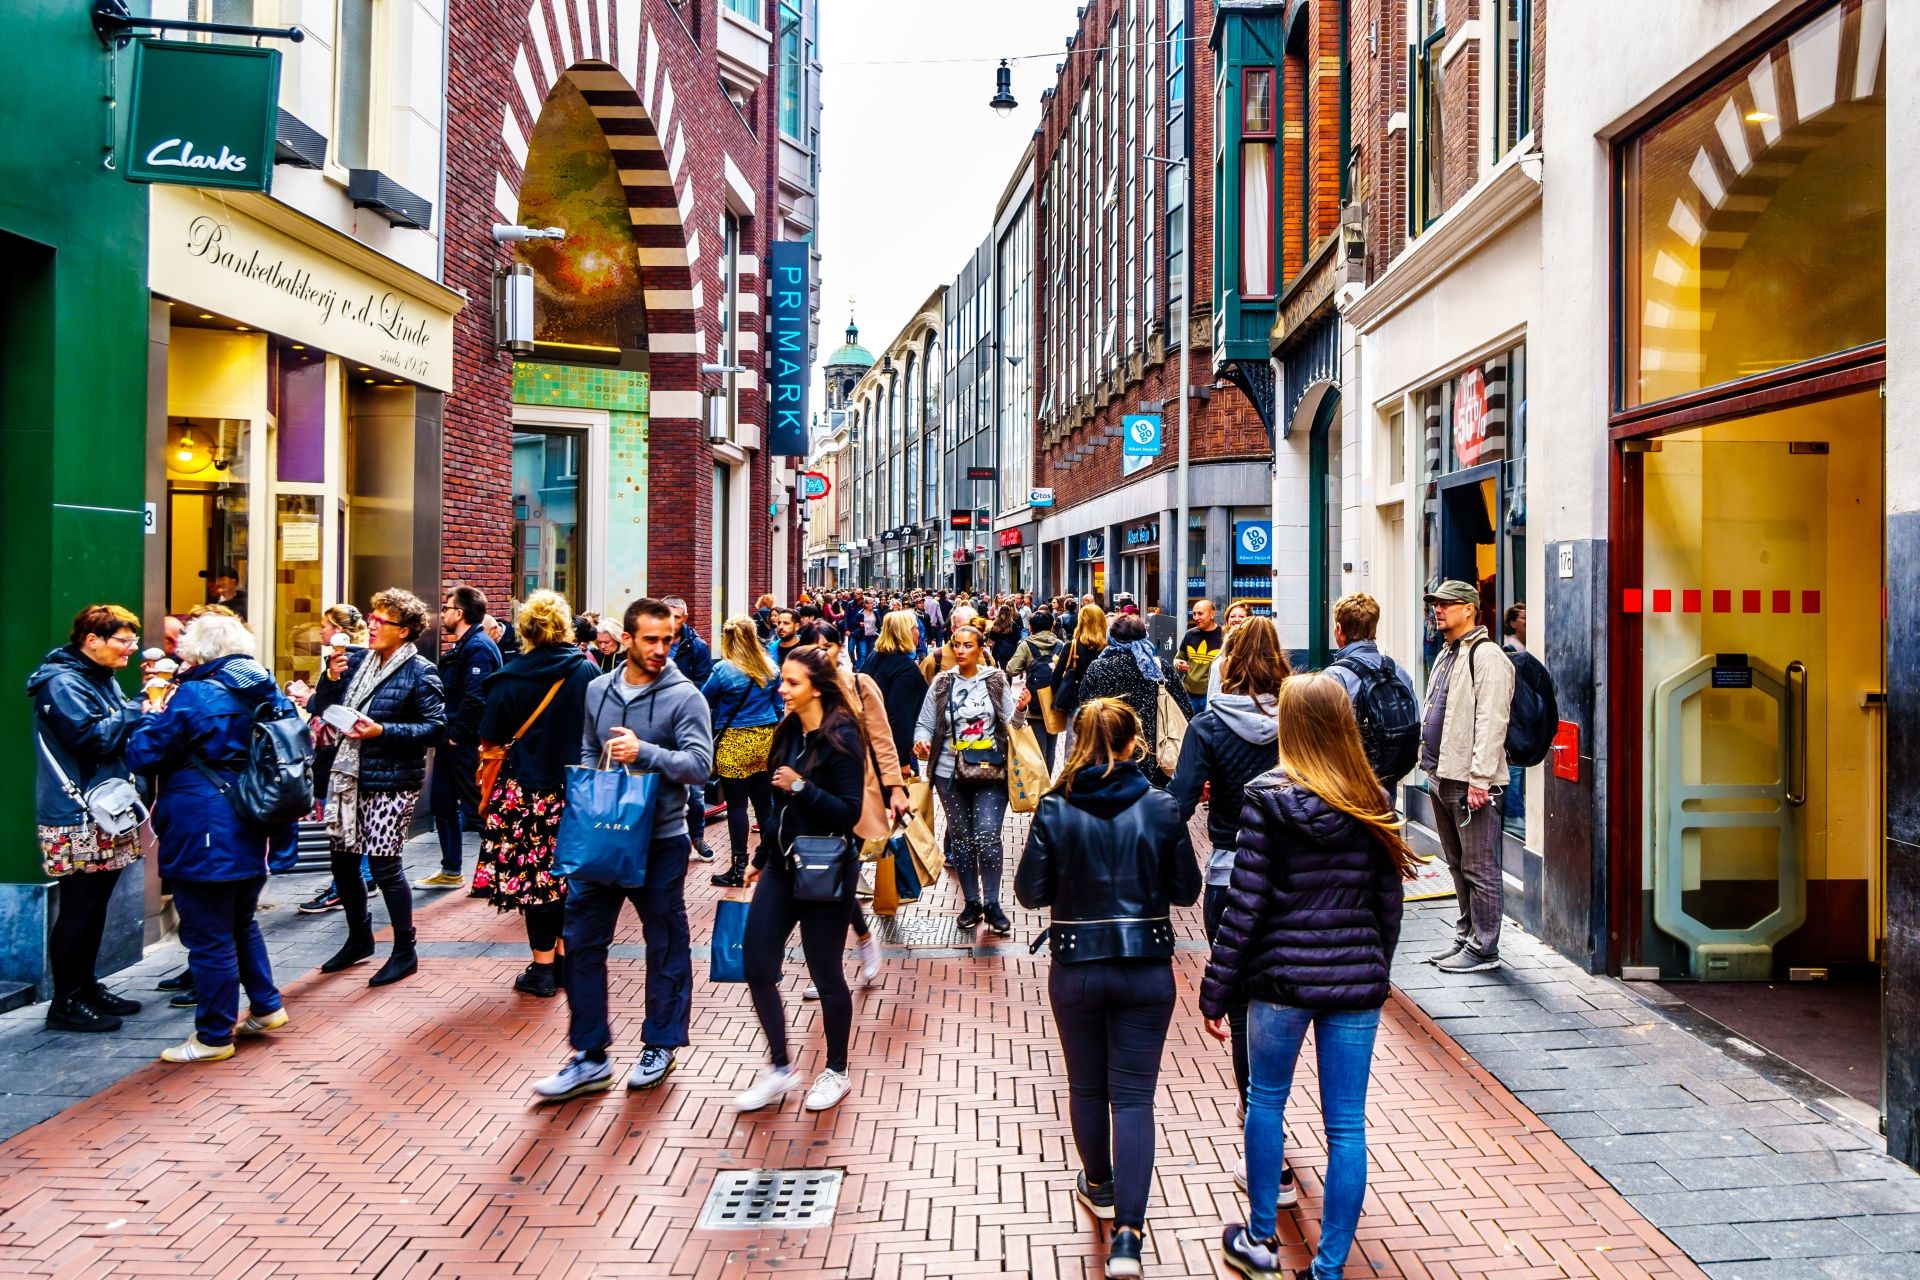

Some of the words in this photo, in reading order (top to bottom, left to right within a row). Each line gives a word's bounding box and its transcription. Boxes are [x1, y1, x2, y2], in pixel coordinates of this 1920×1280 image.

[146, 138, 247, 172] Clarks
[187, 215, 337, 326] Banketbakkerij
[377, 292, 430, 350] Linde
[778, 266, 802, 429] PRIMARK
[379, 348, 401, 366] sinds
[404, 360, 430, 377] 1937
[1135, 423, 1147, 433] to
[1139, 430, 1153, 443] go
[901, 527, 912, 535] JD
[1246, 529, 1260, 540] to
[1251, 536, 1265, 551] go
[593, 822, 631, 831] ZARA
